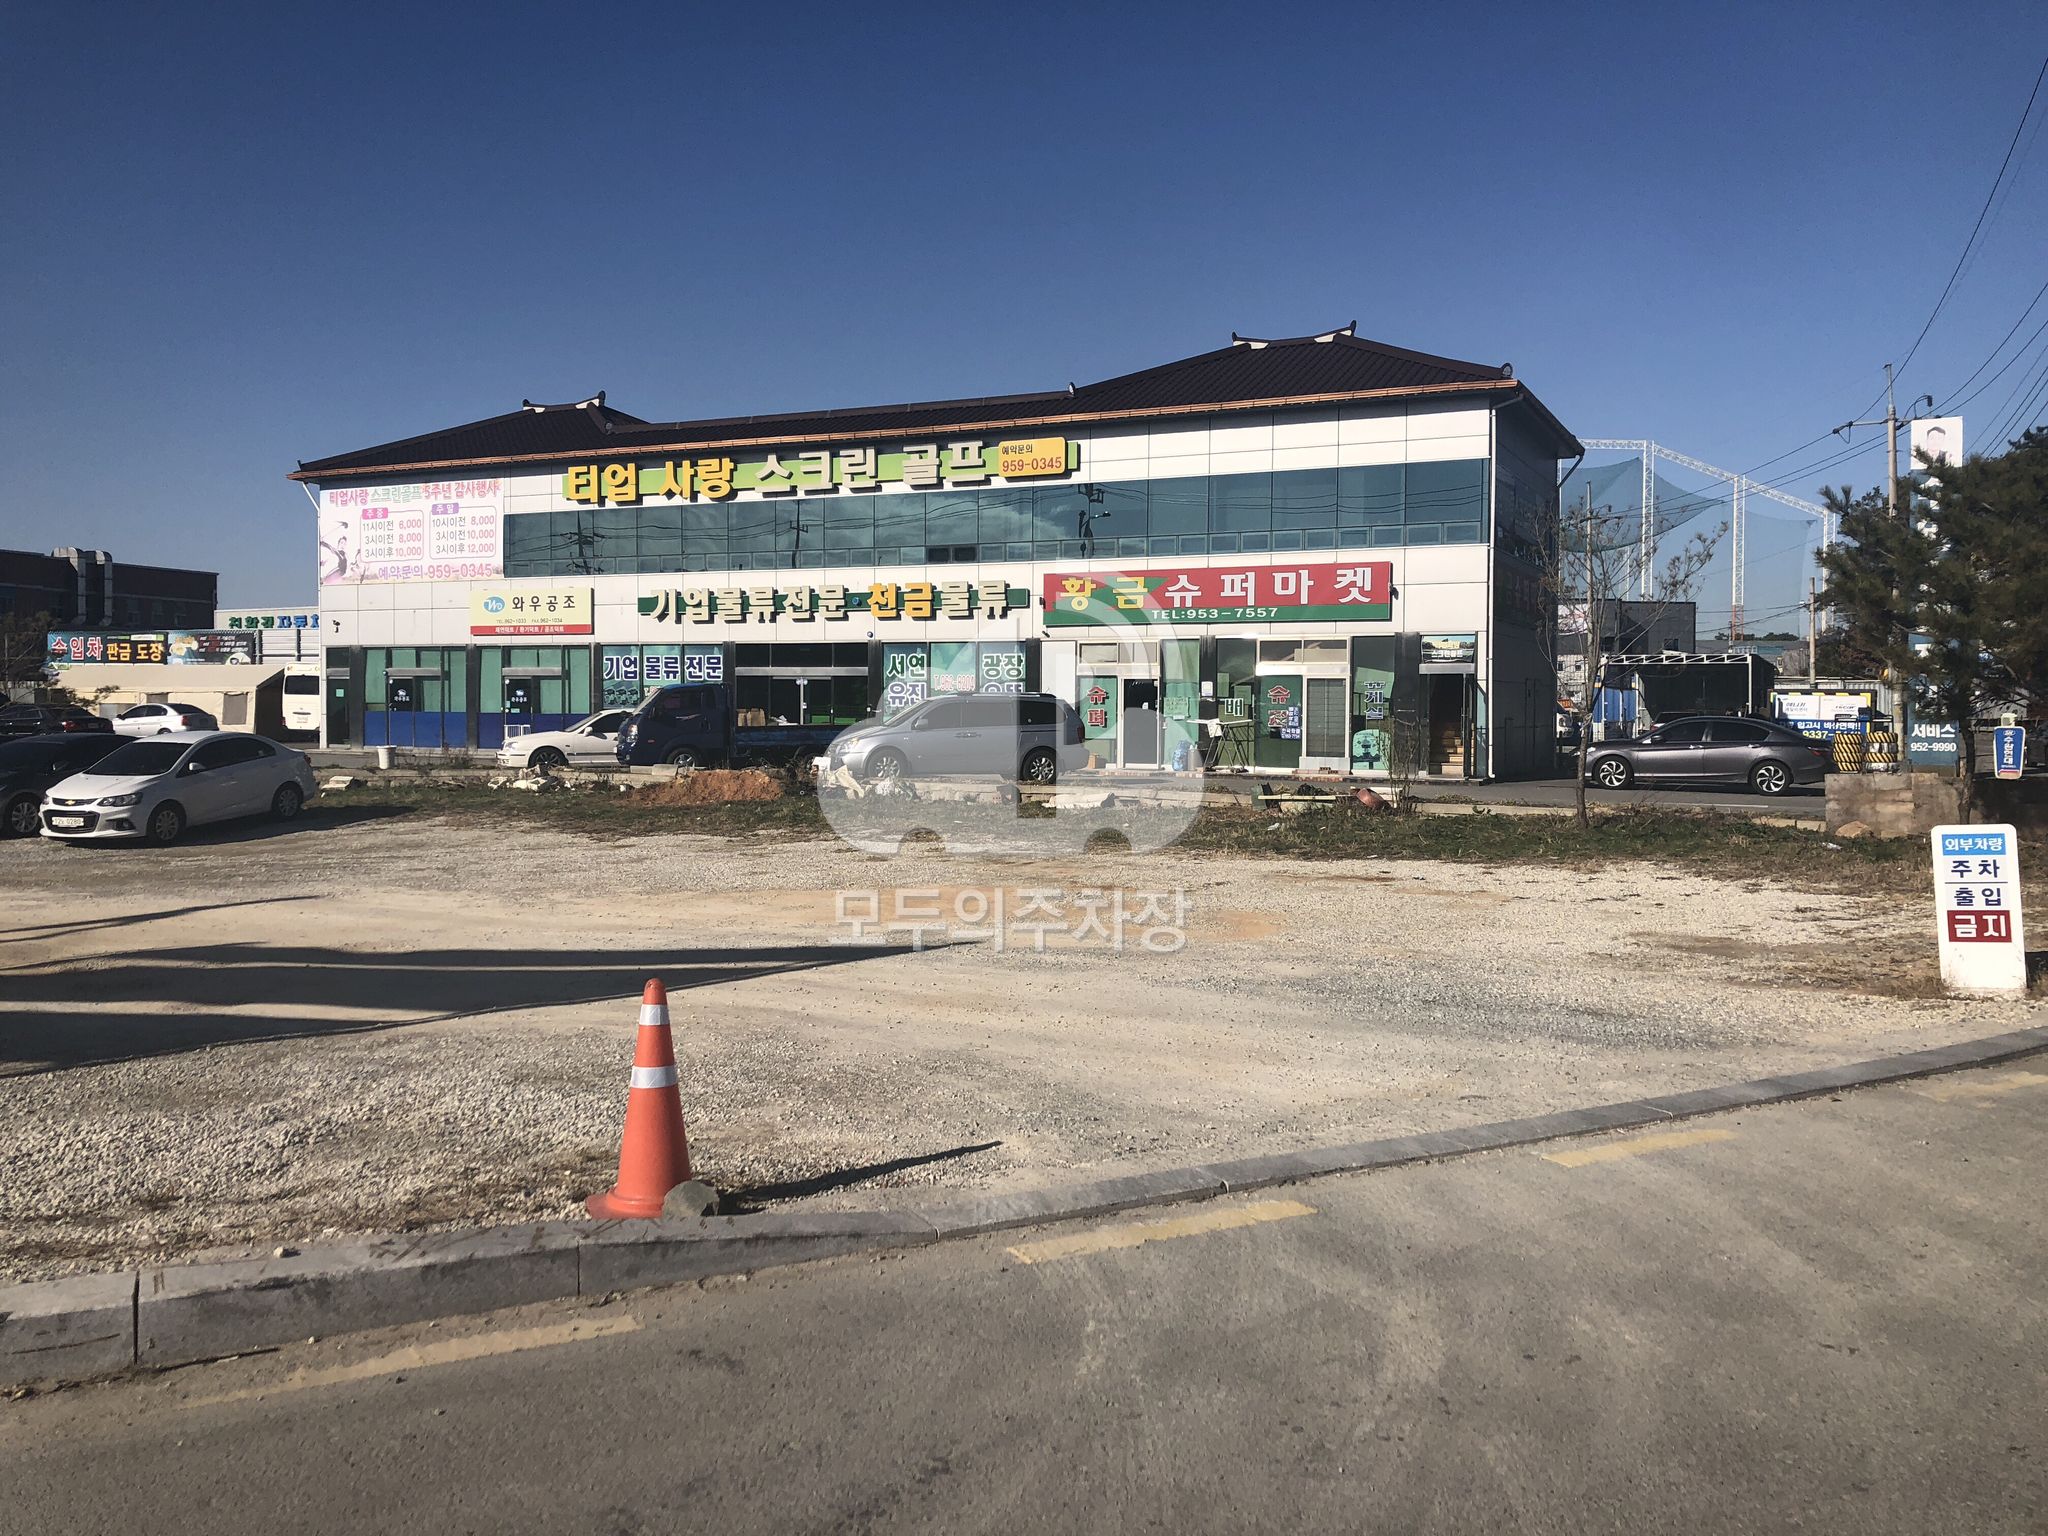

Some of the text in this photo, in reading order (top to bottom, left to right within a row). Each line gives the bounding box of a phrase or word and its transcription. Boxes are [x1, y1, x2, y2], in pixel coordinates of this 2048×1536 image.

[1002, 444, 1033, 455] 예약문의
[567, 440, 986, 503] 티업 사랑 스크린 골프
[1002, 457, 1062, 472] 959-0345
[329, 489, 369, 507] 티업사랑
[363, 520, 394, 532] 11시이전
[432, 515, 494, 527] 10시이전 8,000
[365, 534, 394, 544] 3시이전
[436, 529, 494, 541] 3시이전 10,000
[365, 547, 421, 558] 3시이후 10,000
[436, 543, 494, 555] 3시이후 12,000
[379, 563, 492, 580] 예약문의 959-0345
[512, 595, 576, 612] 와우공조
[51, 636, 164, 662] 수입차 판금 도장
[604, 655, 723, 680] 기업 물류 전문
[888, 653, 928, 679] 서연
[982, 653, 1025, 679] 광장
[1912, 723, 1956, 738] 서비스
[1910, 742, 1957, 752] 952-9990
[1945, 837, 2003, 852] 외부차량
[1951, 859, 2000, 878] 주차
[1954, 887, 2002, 907] 출입
[1954, 914, 2007, 938] 금지
